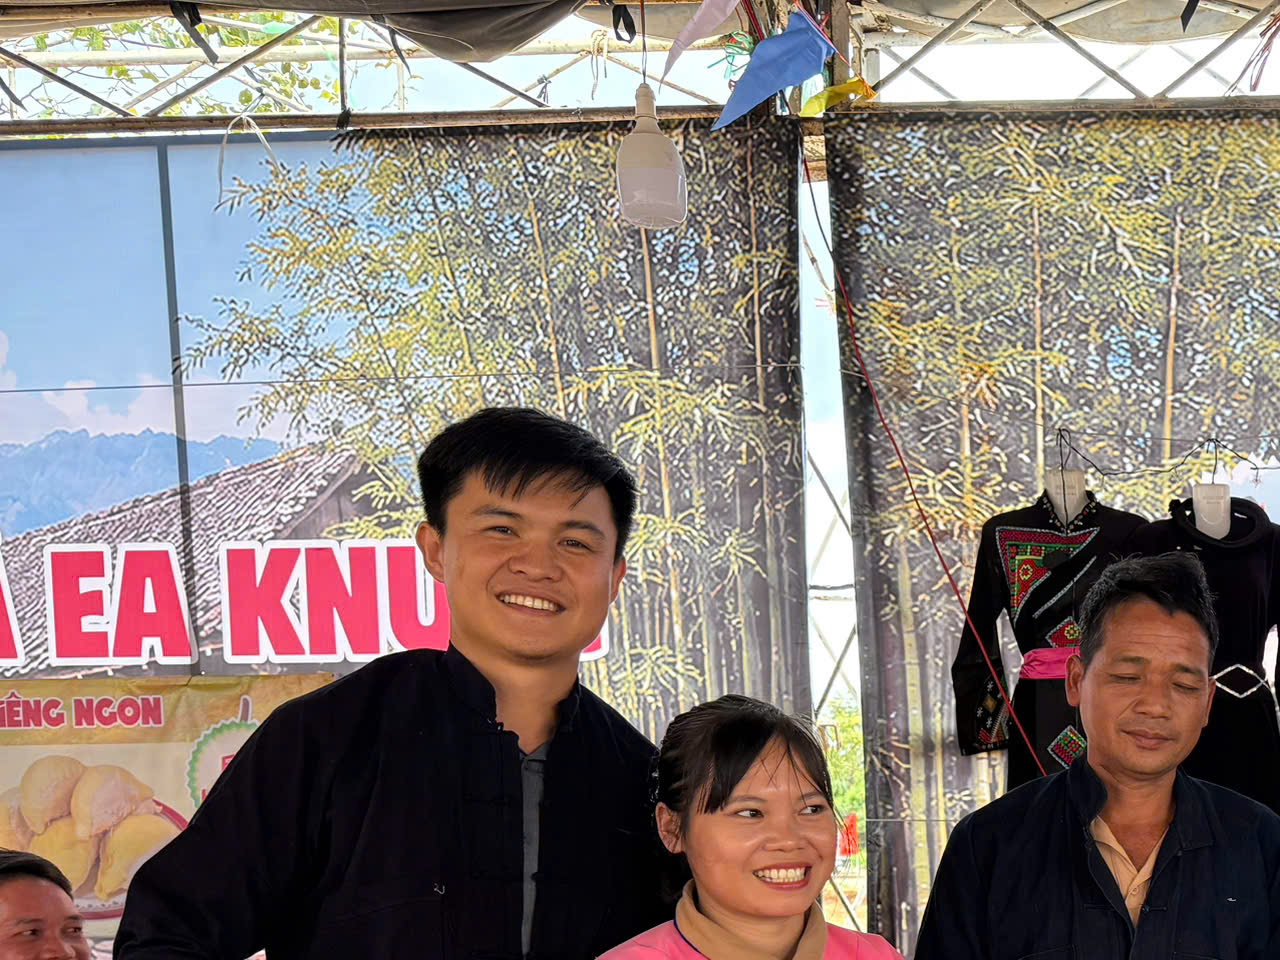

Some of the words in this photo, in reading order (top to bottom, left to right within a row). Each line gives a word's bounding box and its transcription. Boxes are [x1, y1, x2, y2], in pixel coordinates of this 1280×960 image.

[49, 547, 195, 660] EA
[224, 544, 606, 662] KNU
[73, 697, 163, 727] NGON
